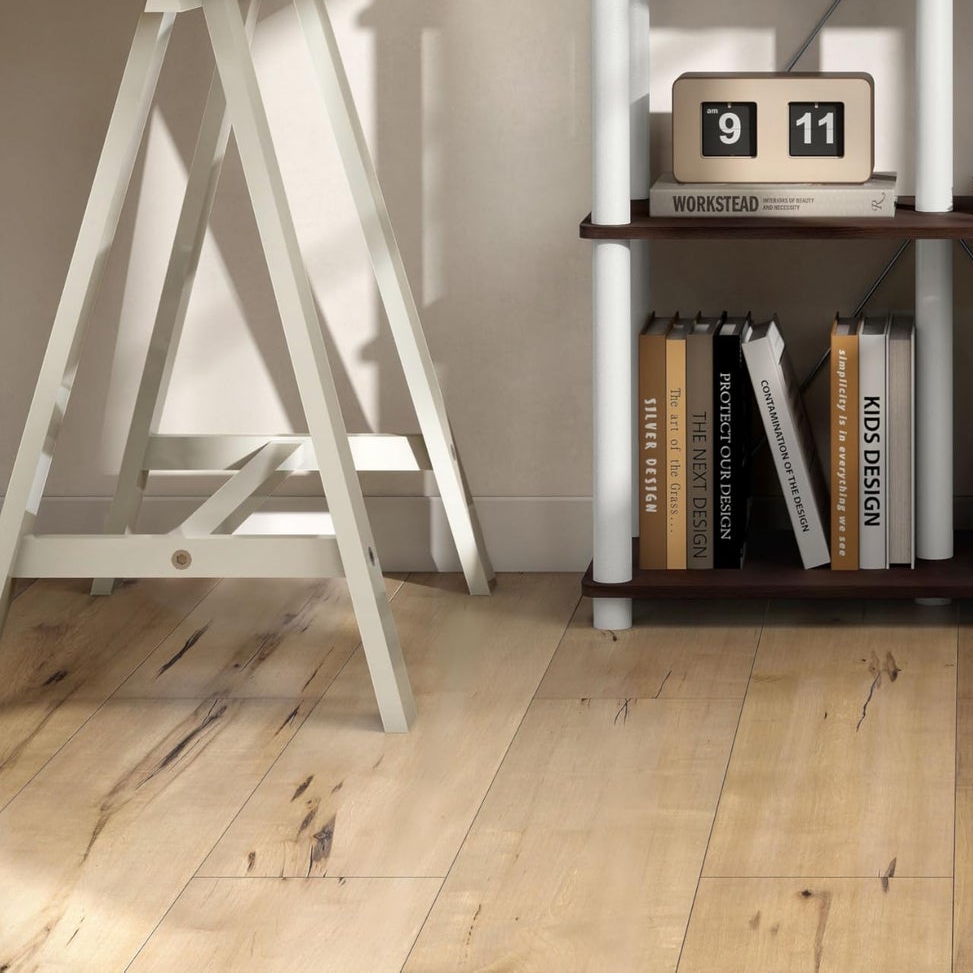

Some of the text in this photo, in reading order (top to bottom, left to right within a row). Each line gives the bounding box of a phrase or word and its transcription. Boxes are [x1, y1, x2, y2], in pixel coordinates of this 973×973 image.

[718, 112, 834, 145] 9 11
[672, 195, 759, 213] WORKSTEAD
[670, 388, 682, 407] The
[670, 413, 681, 431] art
[644, 398, 657, 513] SILVER DESIGN
[670, 438, 682, 452] of
[670, 458, 682, 477] the
[719, 372, 731, 540] PROTECT OUR DESIGN
[760, 379, 810, 533] CONTAMINATION OF THE DESIGN
[837, 349, 848, 557] simplicity is in everything we see
[864, 396, 880, 527] KIDS DESIGN
[692, 411, 708, 558] THE NEXT DESIGN
